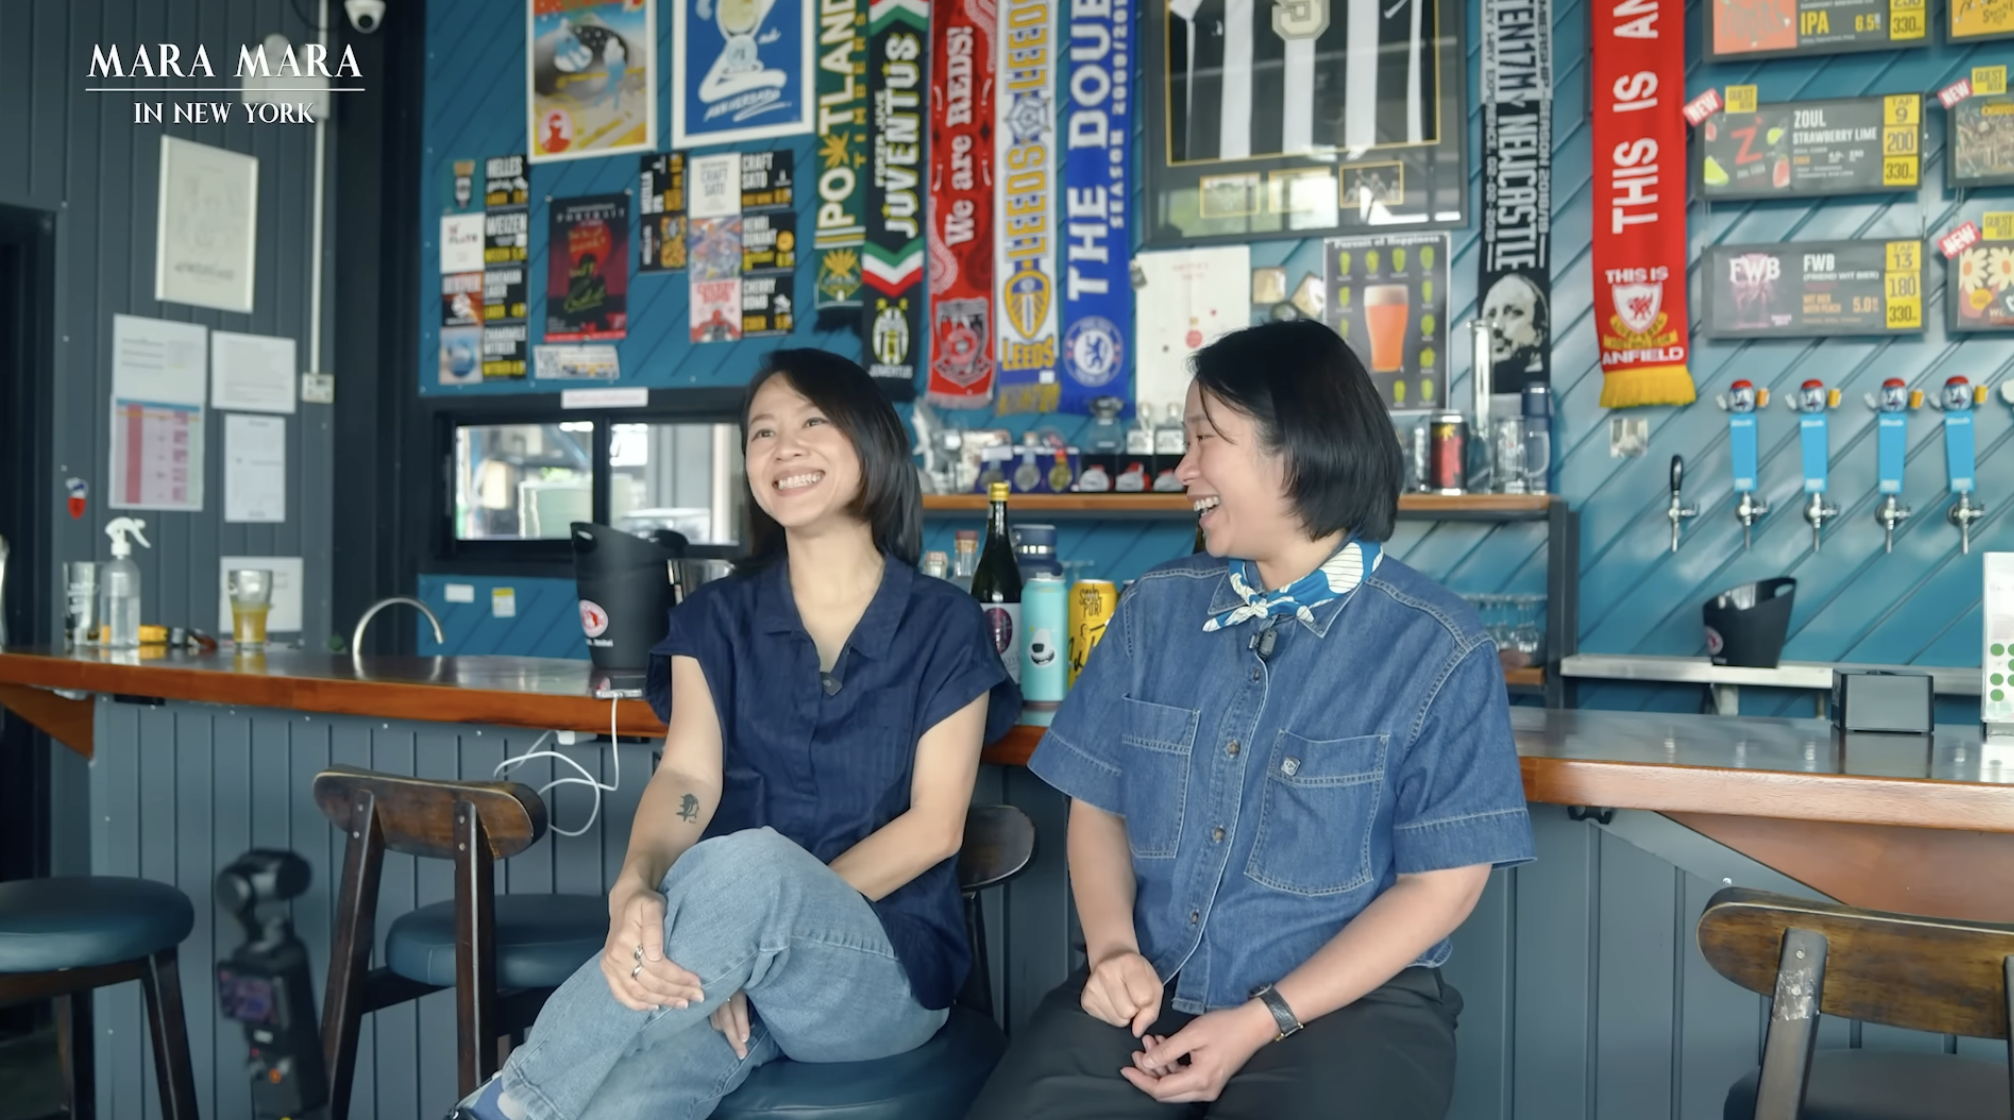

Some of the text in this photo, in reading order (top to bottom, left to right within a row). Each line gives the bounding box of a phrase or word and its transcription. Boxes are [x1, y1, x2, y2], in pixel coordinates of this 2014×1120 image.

[1800, 10, 1830, 35] IPA
[1893, 16, 1916, 33] 330
[1006, 0, 1047, 90] LEED
[854, 12, 867, 168] TIMBERS
[1612, 70, 1658, 112] IS
[1941, 80, 1971, 106] NEW
[874, 90, 887, 132] JUVE
[1686, 91, 1720, 123] NEW
[1793, 109, 1827, 129] ZOUL
[1895, 106, 1908, 122] 9
[884, 33, 920, 239] JUVENTUS
[945, 26, 974, 247] We are REDS!
[1538, 101, 1550, 167] SEASON
[1792, 126, 1878, 145] STRAWBERRY LIME
[1886, 130, 1914, 153] 200
[742, 152, 774, 172] CRAFT
[1885, 162, 1909, 180] 330
[1110, 129, 1124, 229] SEASON
[1495, 113, 1539, 271] NEWCASTLE
[1612, 138, 1658, 234] THIS
[1006, 144, 1047, 260] LEEDS
[486, 213, 528, 236] WEIZEN
[1067, 186, 1109, 300] THE
[1942, 223, 1977, 255] NEW
[1605, 265, 1669, 284] THIS IS
[1729, 255, 1781, 286] FWB
[1803, 253, 1835, 272] FWB
[1894, 253, 1913, 269] 13
[1889, 276, 1916, 298] 180
[1889, 306, 1912, 322] 330
[1002, 335, 1056, 371] LEEDS
[1602, 346, 1685, 366] ANFIELD
